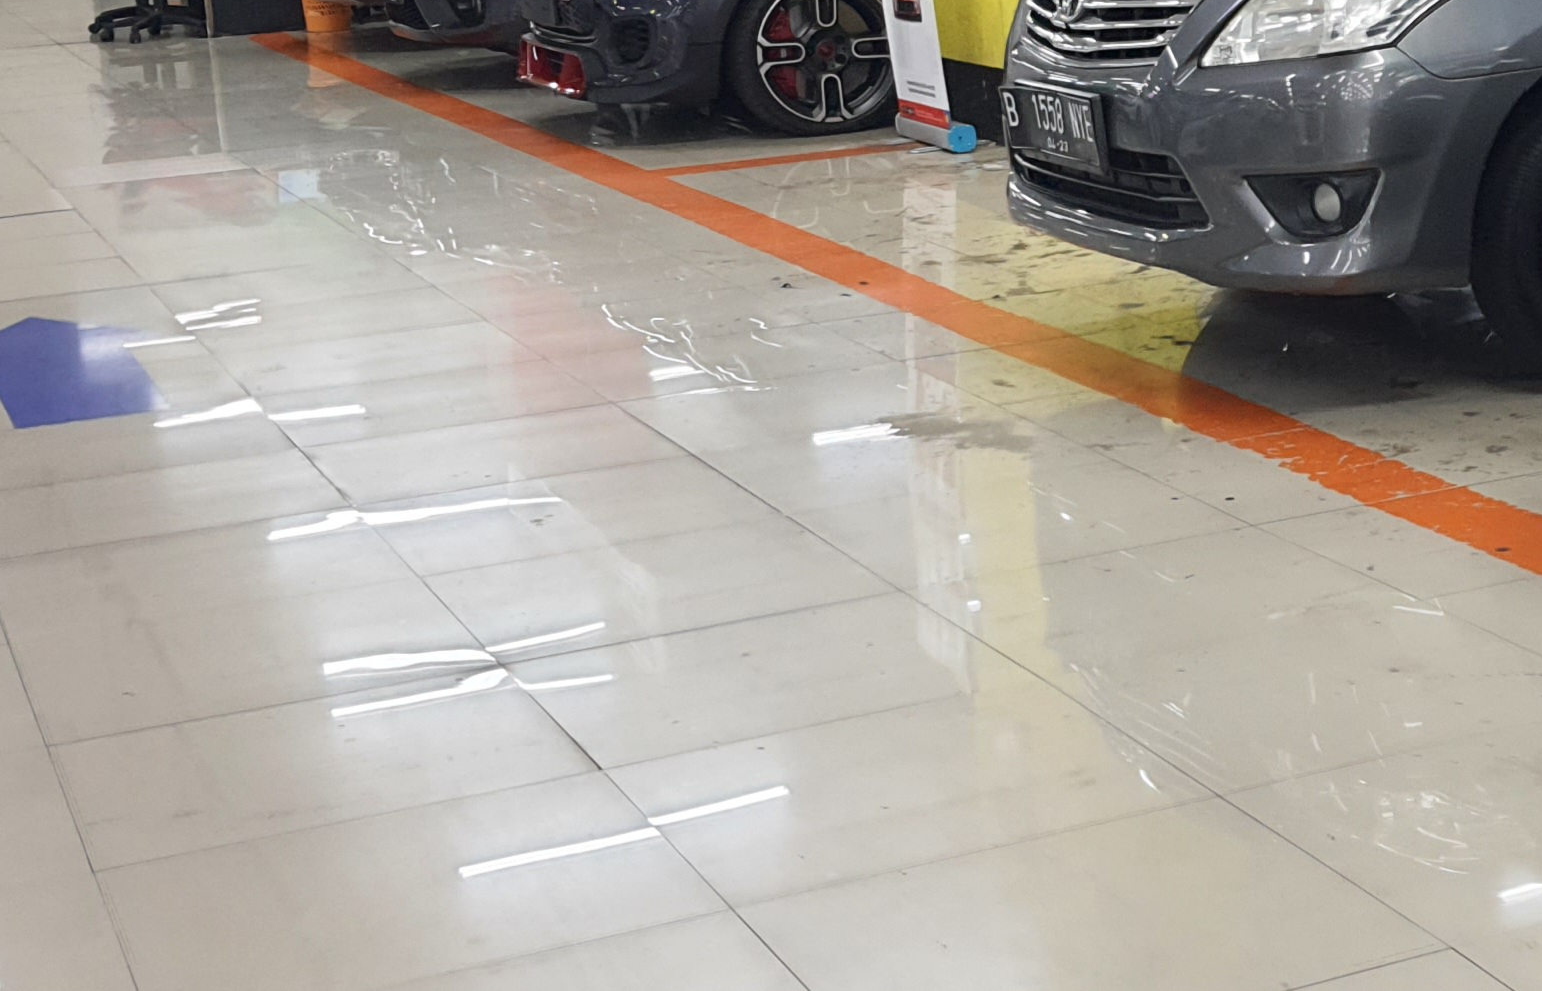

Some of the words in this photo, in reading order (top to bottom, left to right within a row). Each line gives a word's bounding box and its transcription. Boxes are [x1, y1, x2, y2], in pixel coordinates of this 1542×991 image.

[1003, 92, 1019, 127] B
[1031, 93, 1065, 135] 1558
[1068, 101, 1095, 143] NYE
